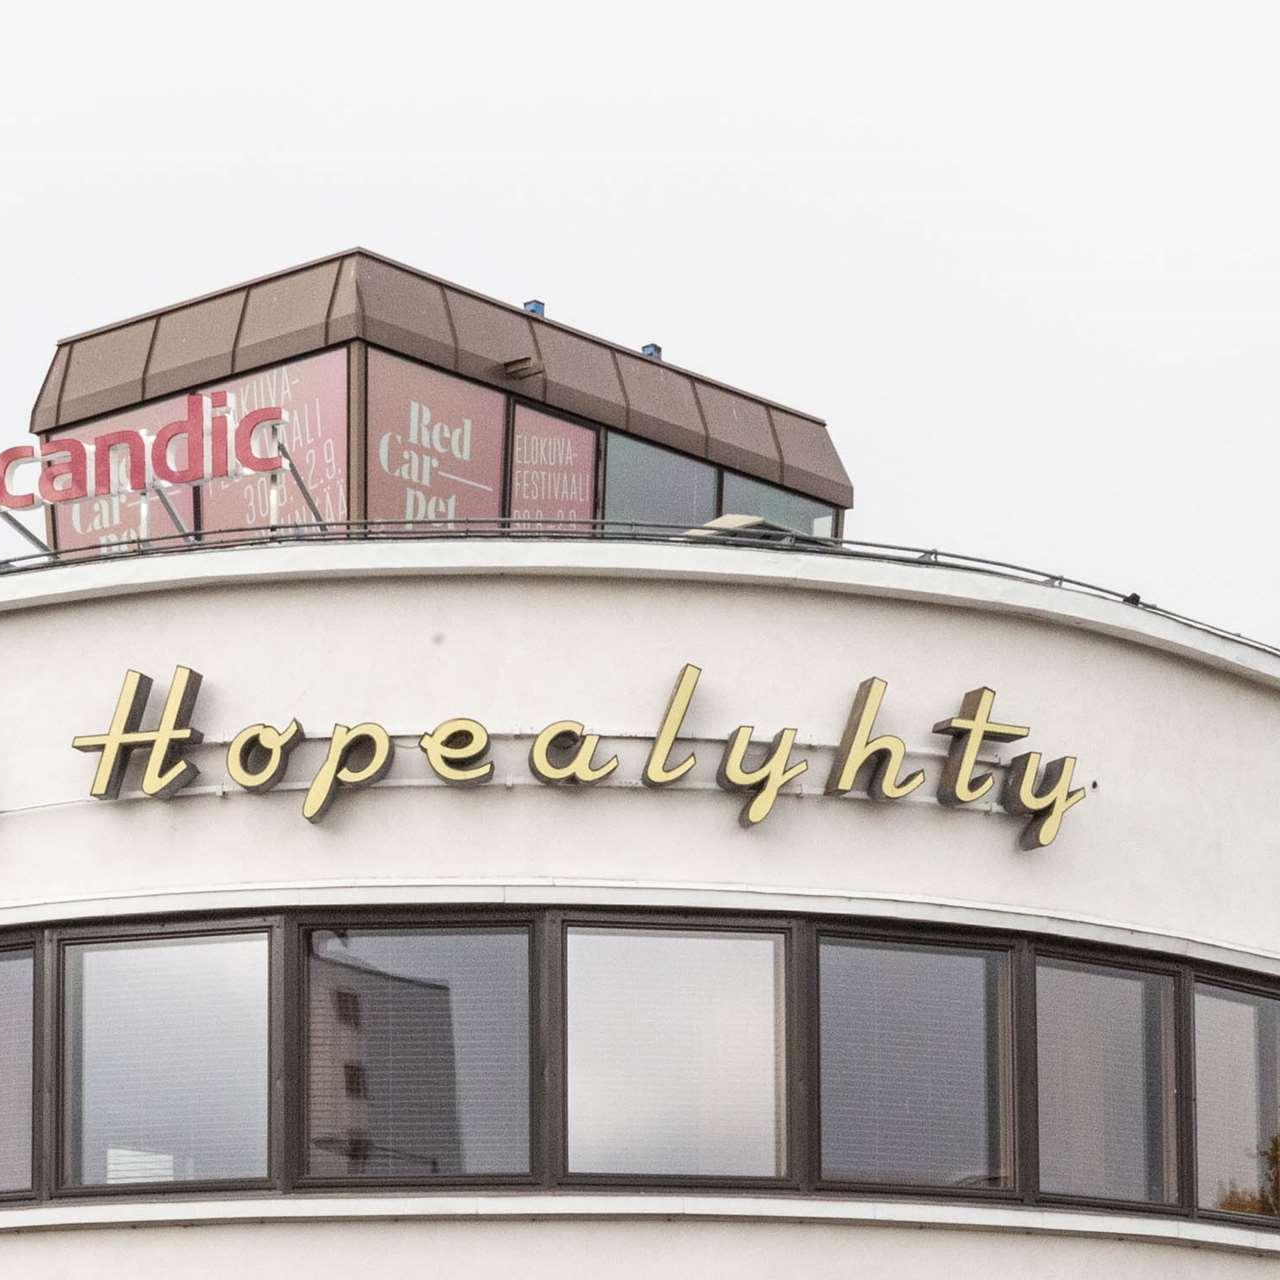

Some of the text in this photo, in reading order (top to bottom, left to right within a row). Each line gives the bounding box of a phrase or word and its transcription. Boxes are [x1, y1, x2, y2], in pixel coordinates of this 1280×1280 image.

[408, 400, 473, 461] Red
[514, 434, 578, 467] ELOKUVA-
[514, 470, 591, 502] FESTIVAALI
[72, 664, 1086, 850] Hopealyhty
